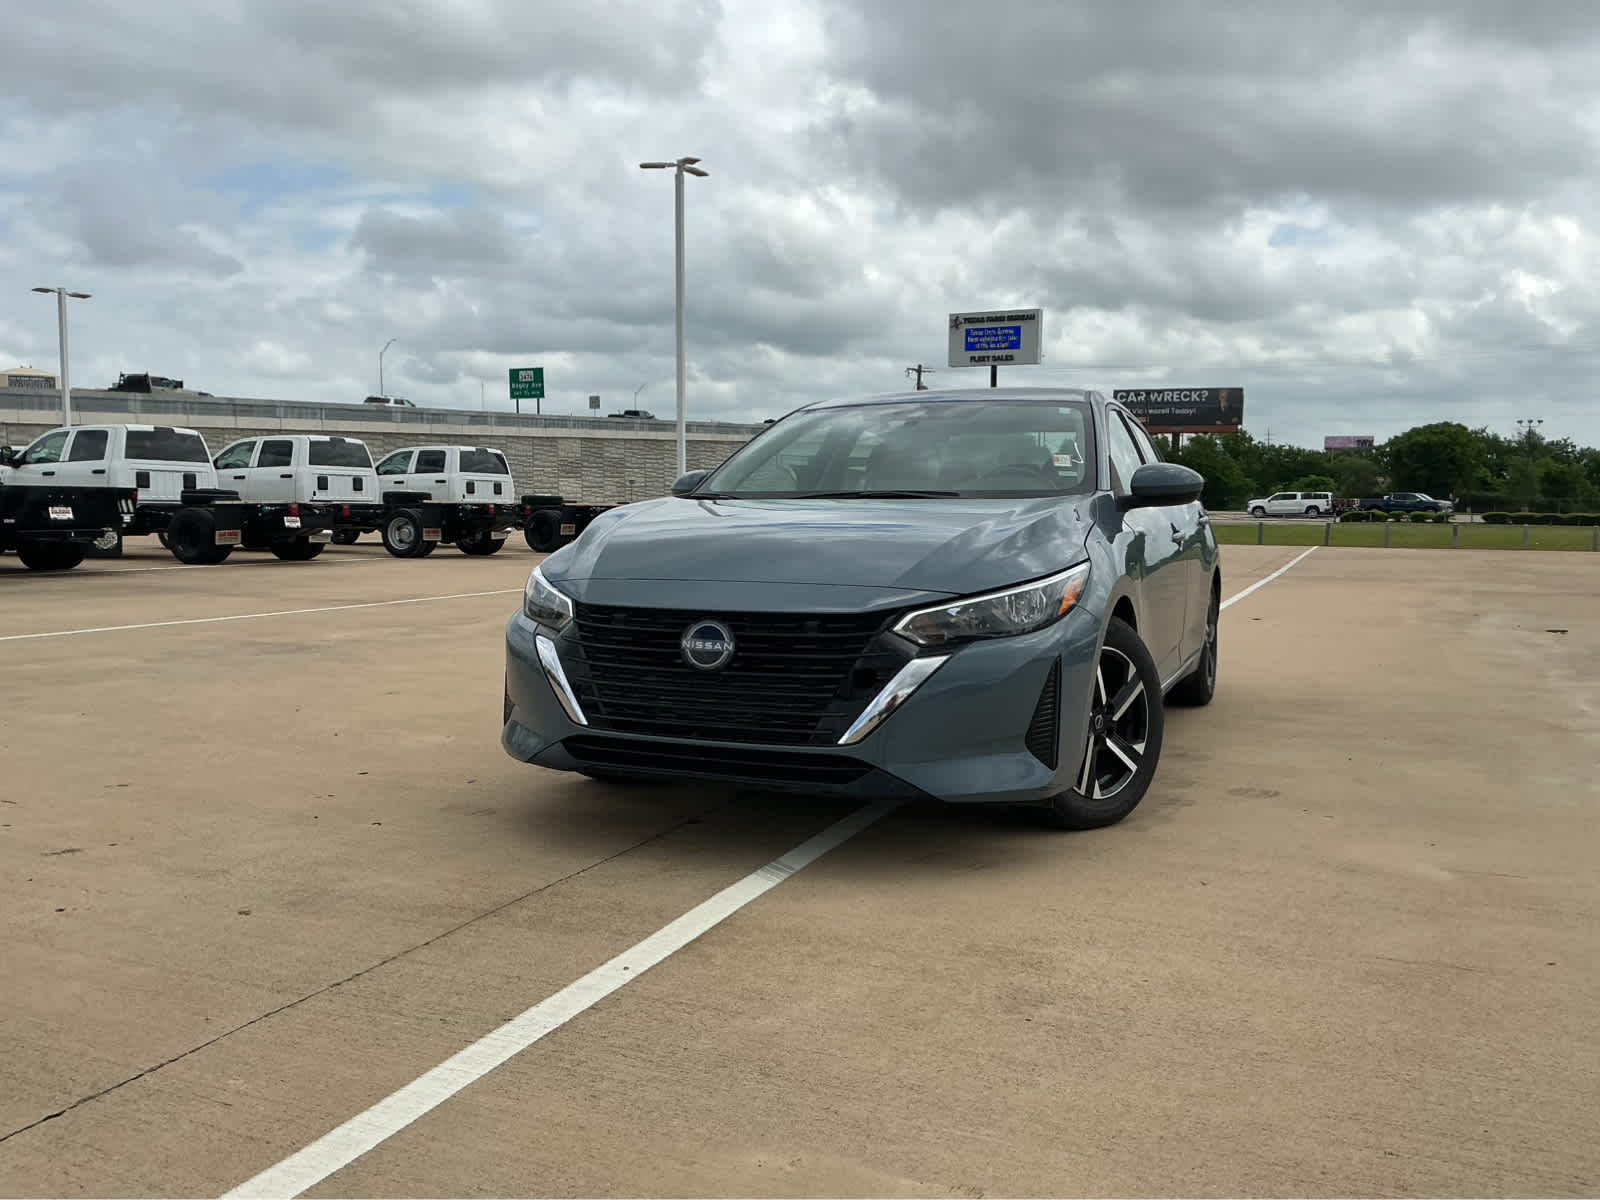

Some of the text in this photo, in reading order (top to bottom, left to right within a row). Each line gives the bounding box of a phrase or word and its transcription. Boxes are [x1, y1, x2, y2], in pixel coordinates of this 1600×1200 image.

[992, 354, 1014, 362] SALES
[1116, 390, 1209, 403] CAR WRECK?
[1171, 407, 1197, 416] Today!
[681, 639, 733, 651] NISSAN
